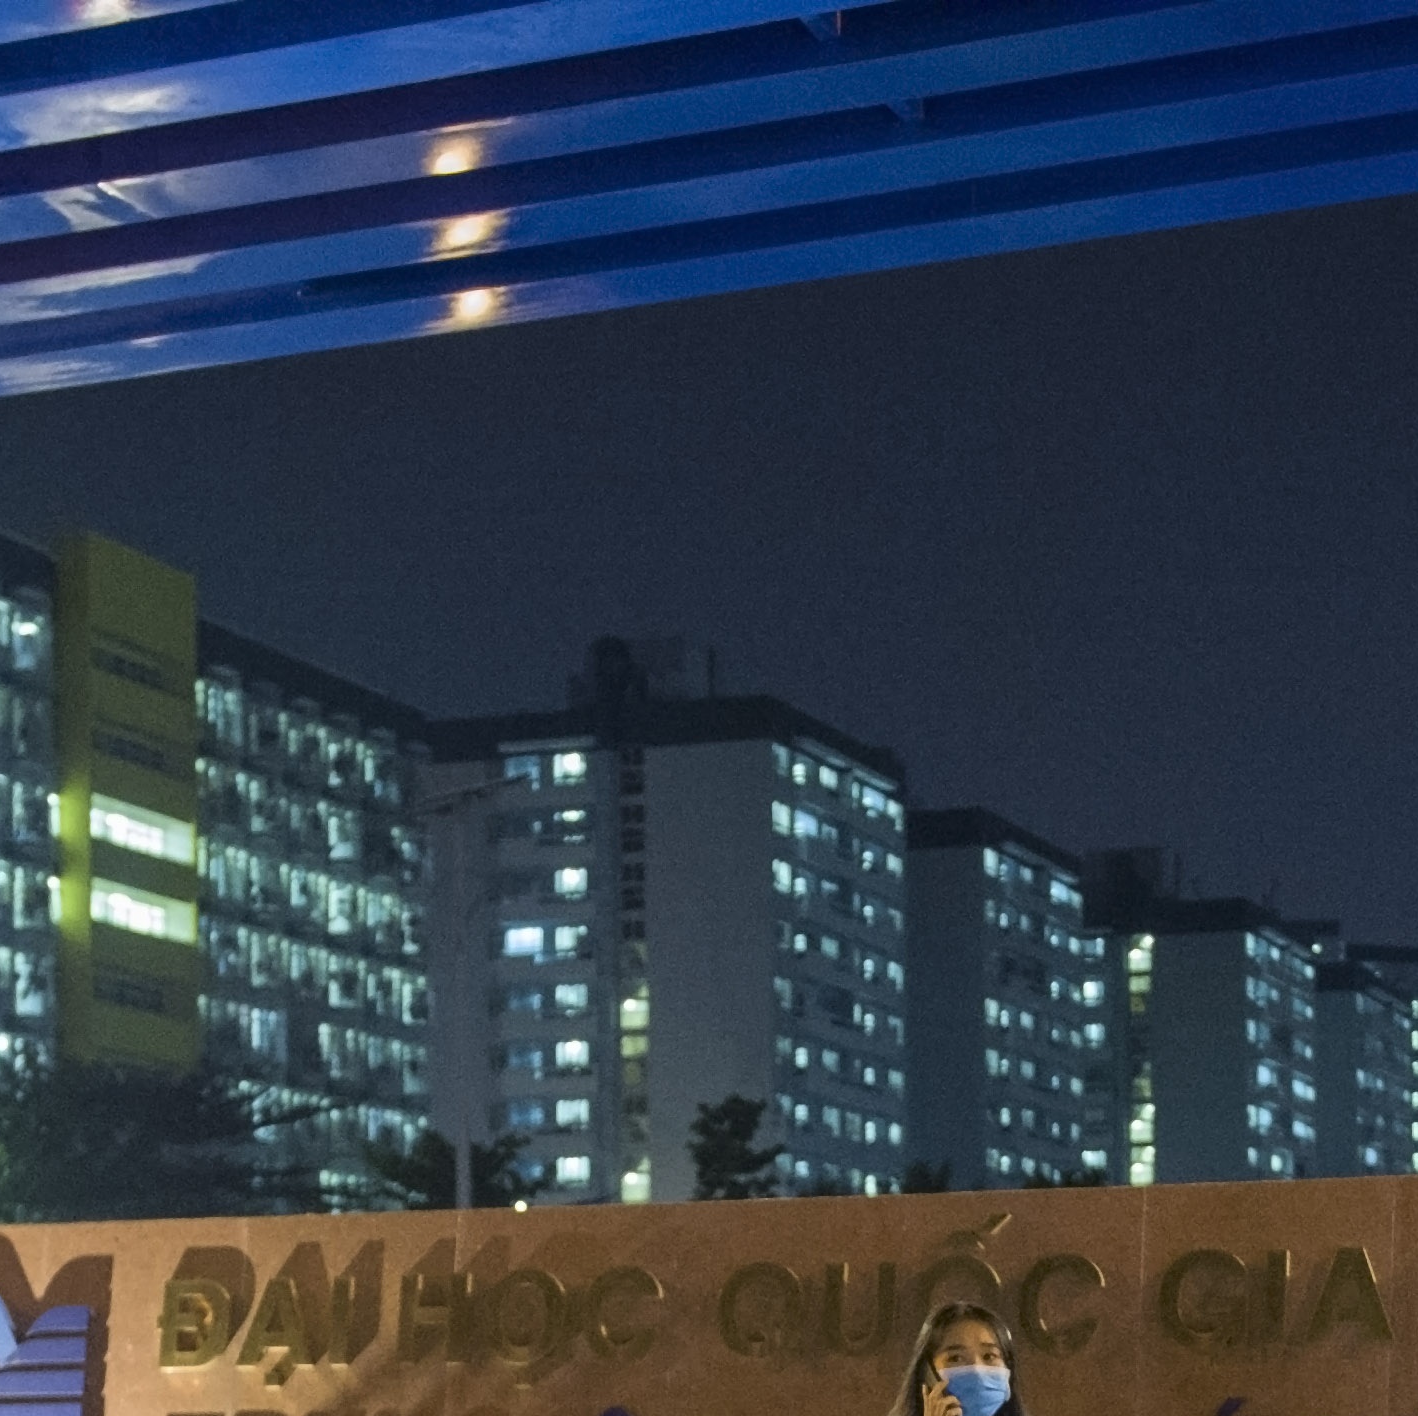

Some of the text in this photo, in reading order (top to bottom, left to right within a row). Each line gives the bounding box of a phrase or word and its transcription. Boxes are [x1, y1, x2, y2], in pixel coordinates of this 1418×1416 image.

[158, 1275, 357, 1391] ĐẠI
[396, 1265, 665, 1389] HỌC
[1159, 1246, 1395, 1346] GIA
